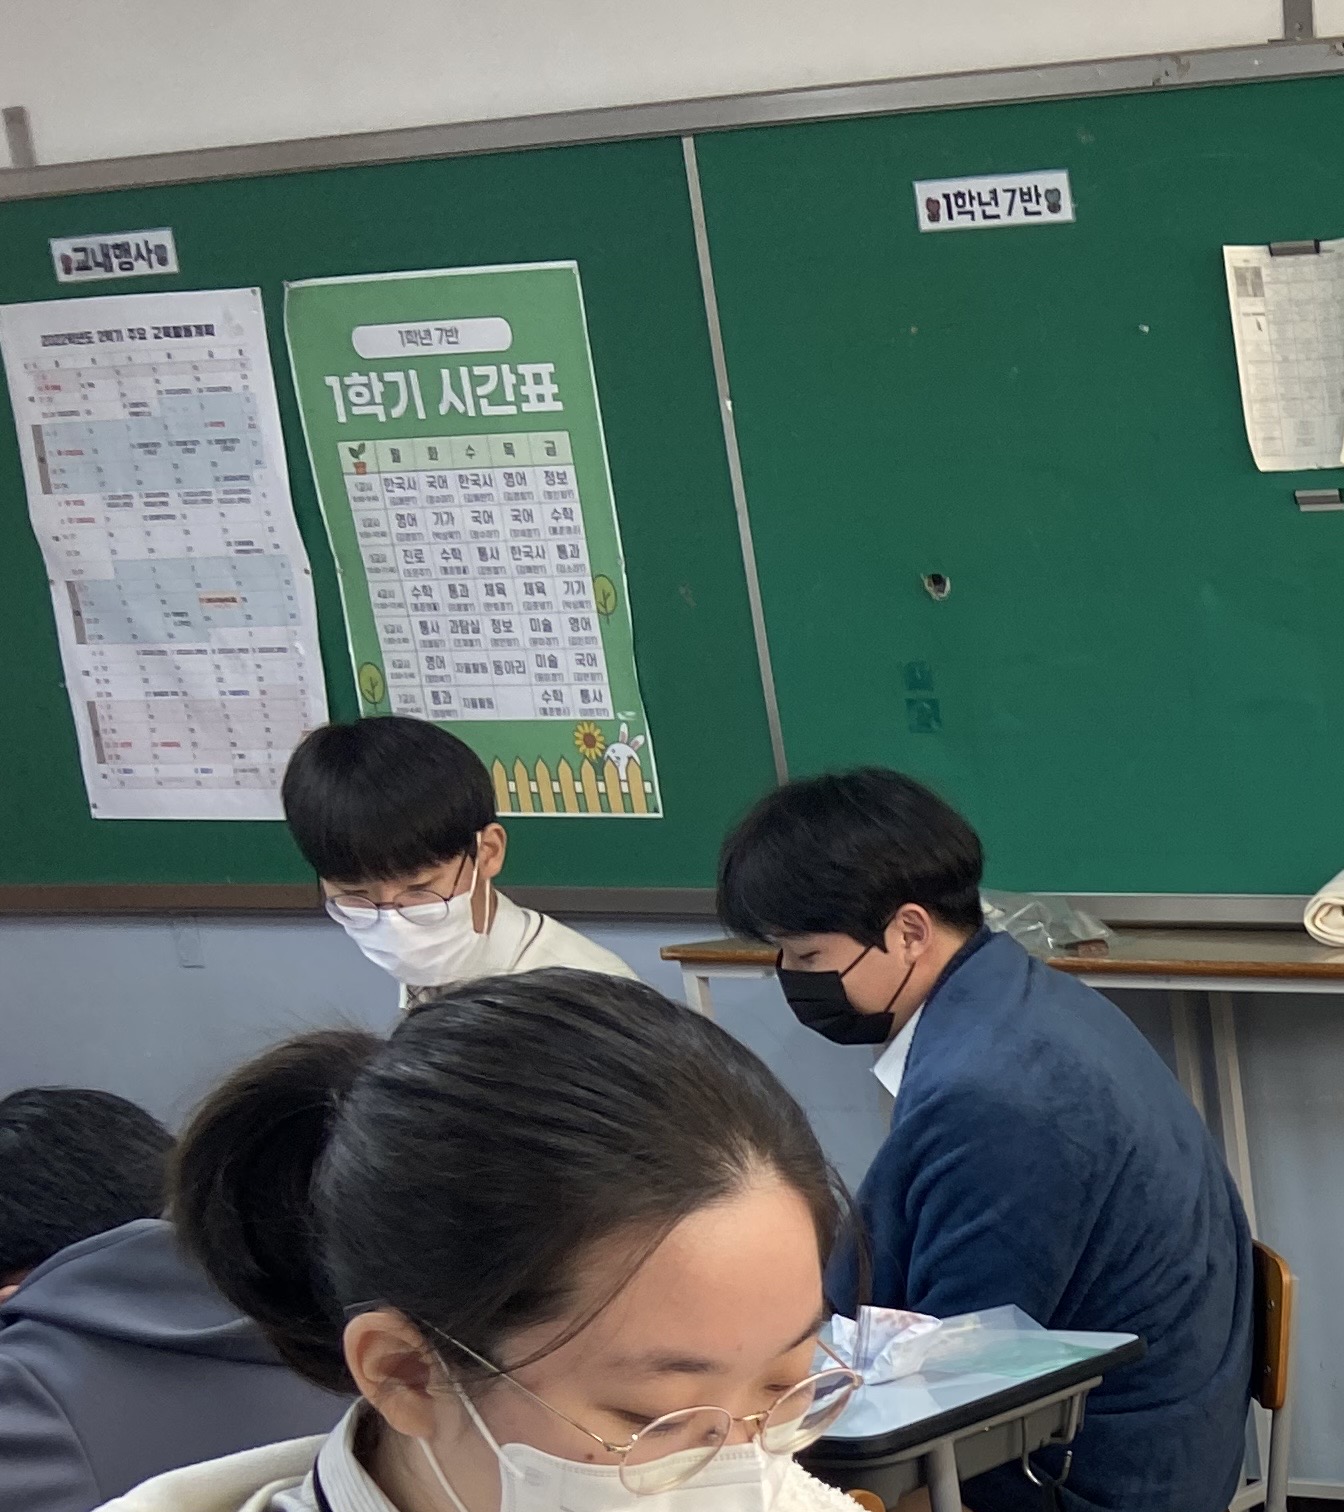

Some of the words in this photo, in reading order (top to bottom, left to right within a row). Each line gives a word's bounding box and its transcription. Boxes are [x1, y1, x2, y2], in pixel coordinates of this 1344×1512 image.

[398, 328, 433, 348] 1학년
[434, 327, 460, 346] 7반
[324, 369, 427, 423] 1학기
[439, 363, 564, 417] 시간표
[465, 444, 476, 460] 수
[544, 440, 557, 457] 금
[383, 476, 418, 493] 한국사
[426, 474, 450, 490] 국어
[458, 472, 495, 490] 한국사
[503, 471, 528, 488] 영어
[544, 470, 568, 486] 정보
[396, 513, 418, 529] 영어
[471, 510, 495, 526] 국어
[511, 508, 535, 524] 국어
[550, 507, 575, 523] 수학
[402, 549, 426, 565] 진로
[440, 547, 463, 563] 수학
[510, 544, 547, 561] 한국사
[411, 585, 434, 600] 수학
[491, 618, 515, 634] 정보
[529, 617, 553, 633] 미술
[569, 616, 593, 632] 영어
[493, 659, 527, 676] 동아리
[535, 653, 558, 669] 미술
[575, 652, 598, 668] 국어
[542, 688, 565, 704] 수학
